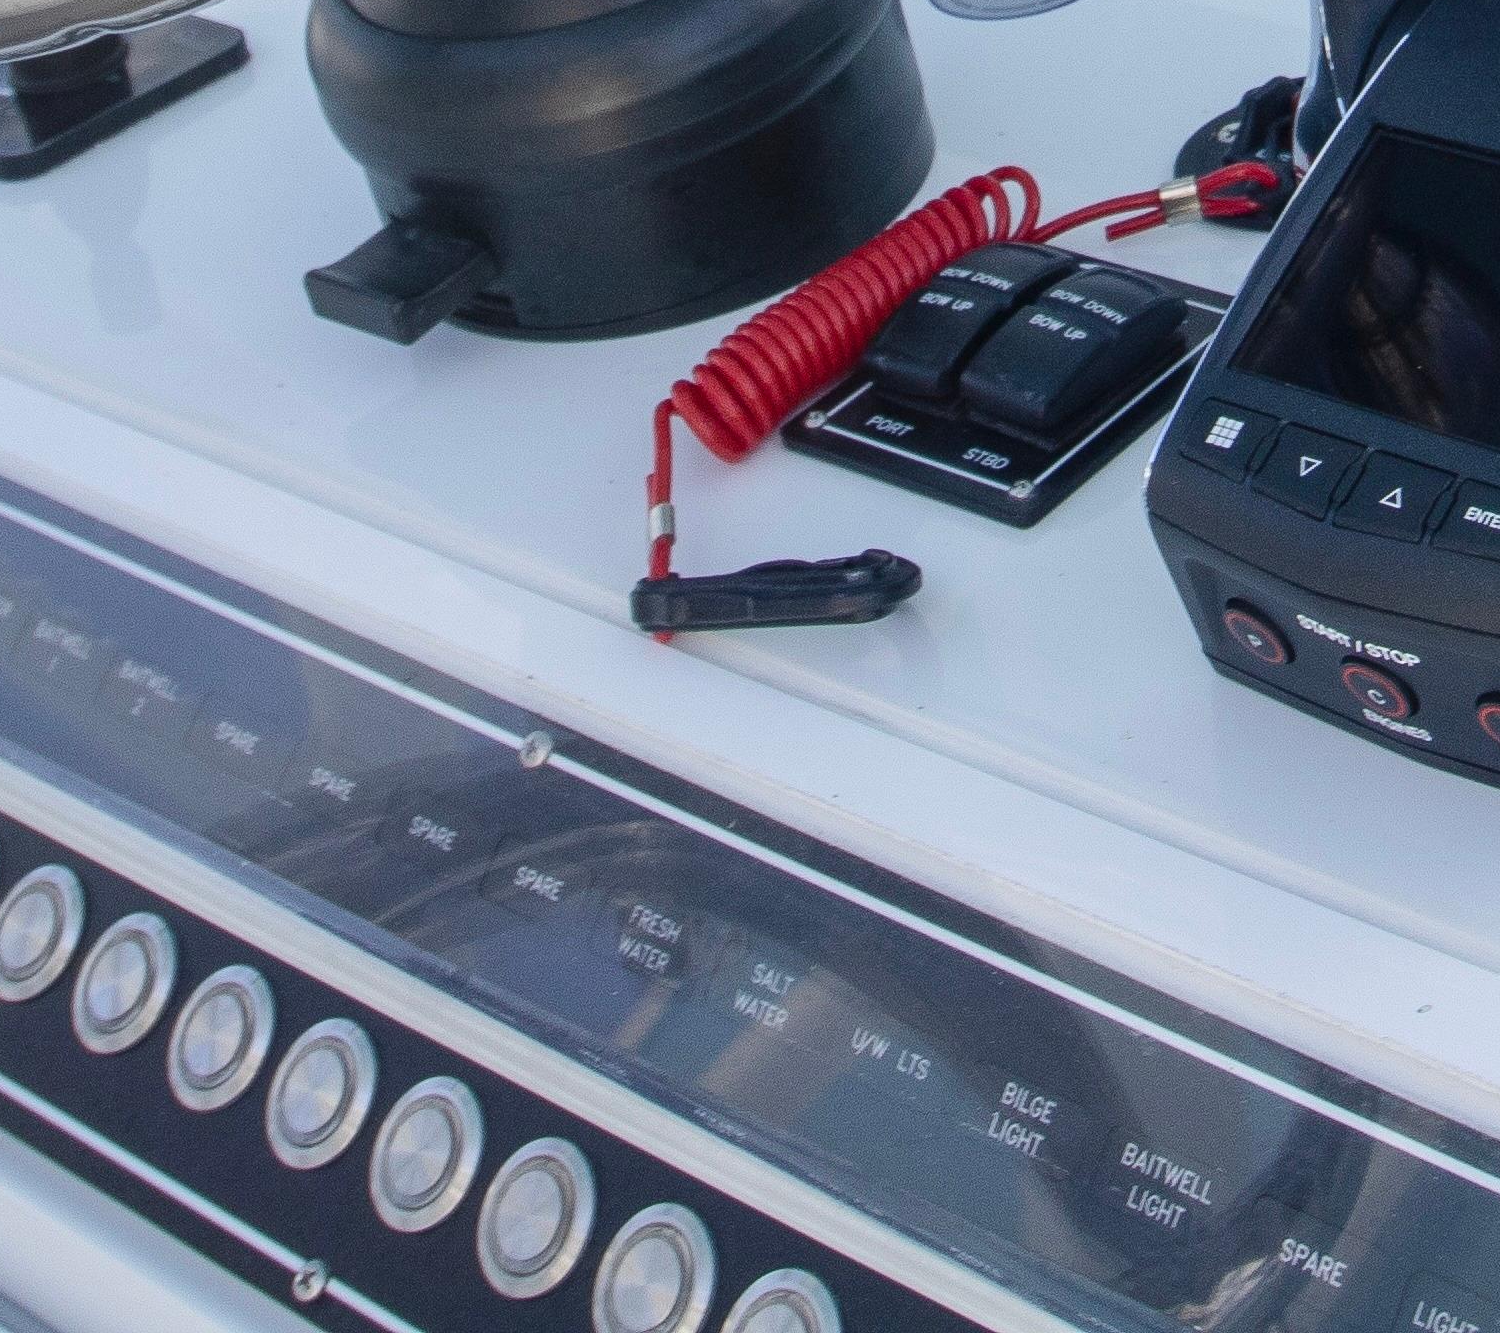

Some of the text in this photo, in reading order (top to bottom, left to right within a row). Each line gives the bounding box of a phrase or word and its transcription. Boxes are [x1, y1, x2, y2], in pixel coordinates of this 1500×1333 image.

[951, 299, 974, 311] UP
[1050, 289, 1129, 325] BOW DOWN
[1029, 314, 1087, 340] BOW UP
[865, 415, 915, 437] PORT
[1364, 643, 1421, 667] STOP
[409, 814, 458, 852] SPARE
[514, 865, 564, 901] SPARE
[629, 904, 682, 944] FRESH
[619, 934, 671, 973] WATER
[751, 963, 796, 995] SALT
[734, 989, 790, 1029] WATER
[897, 1049, 930, 1080] LTS
[1000, 1081, 1058, 1124] BILGE
[988, 1111, 1044, 1158] LIGHT
[1120, 1142, 1212, 1206] BAITWELL
[1126, 1184, 1187, 1229] LIGHT
[1279, 1238, 1348, 1288] SPARE
